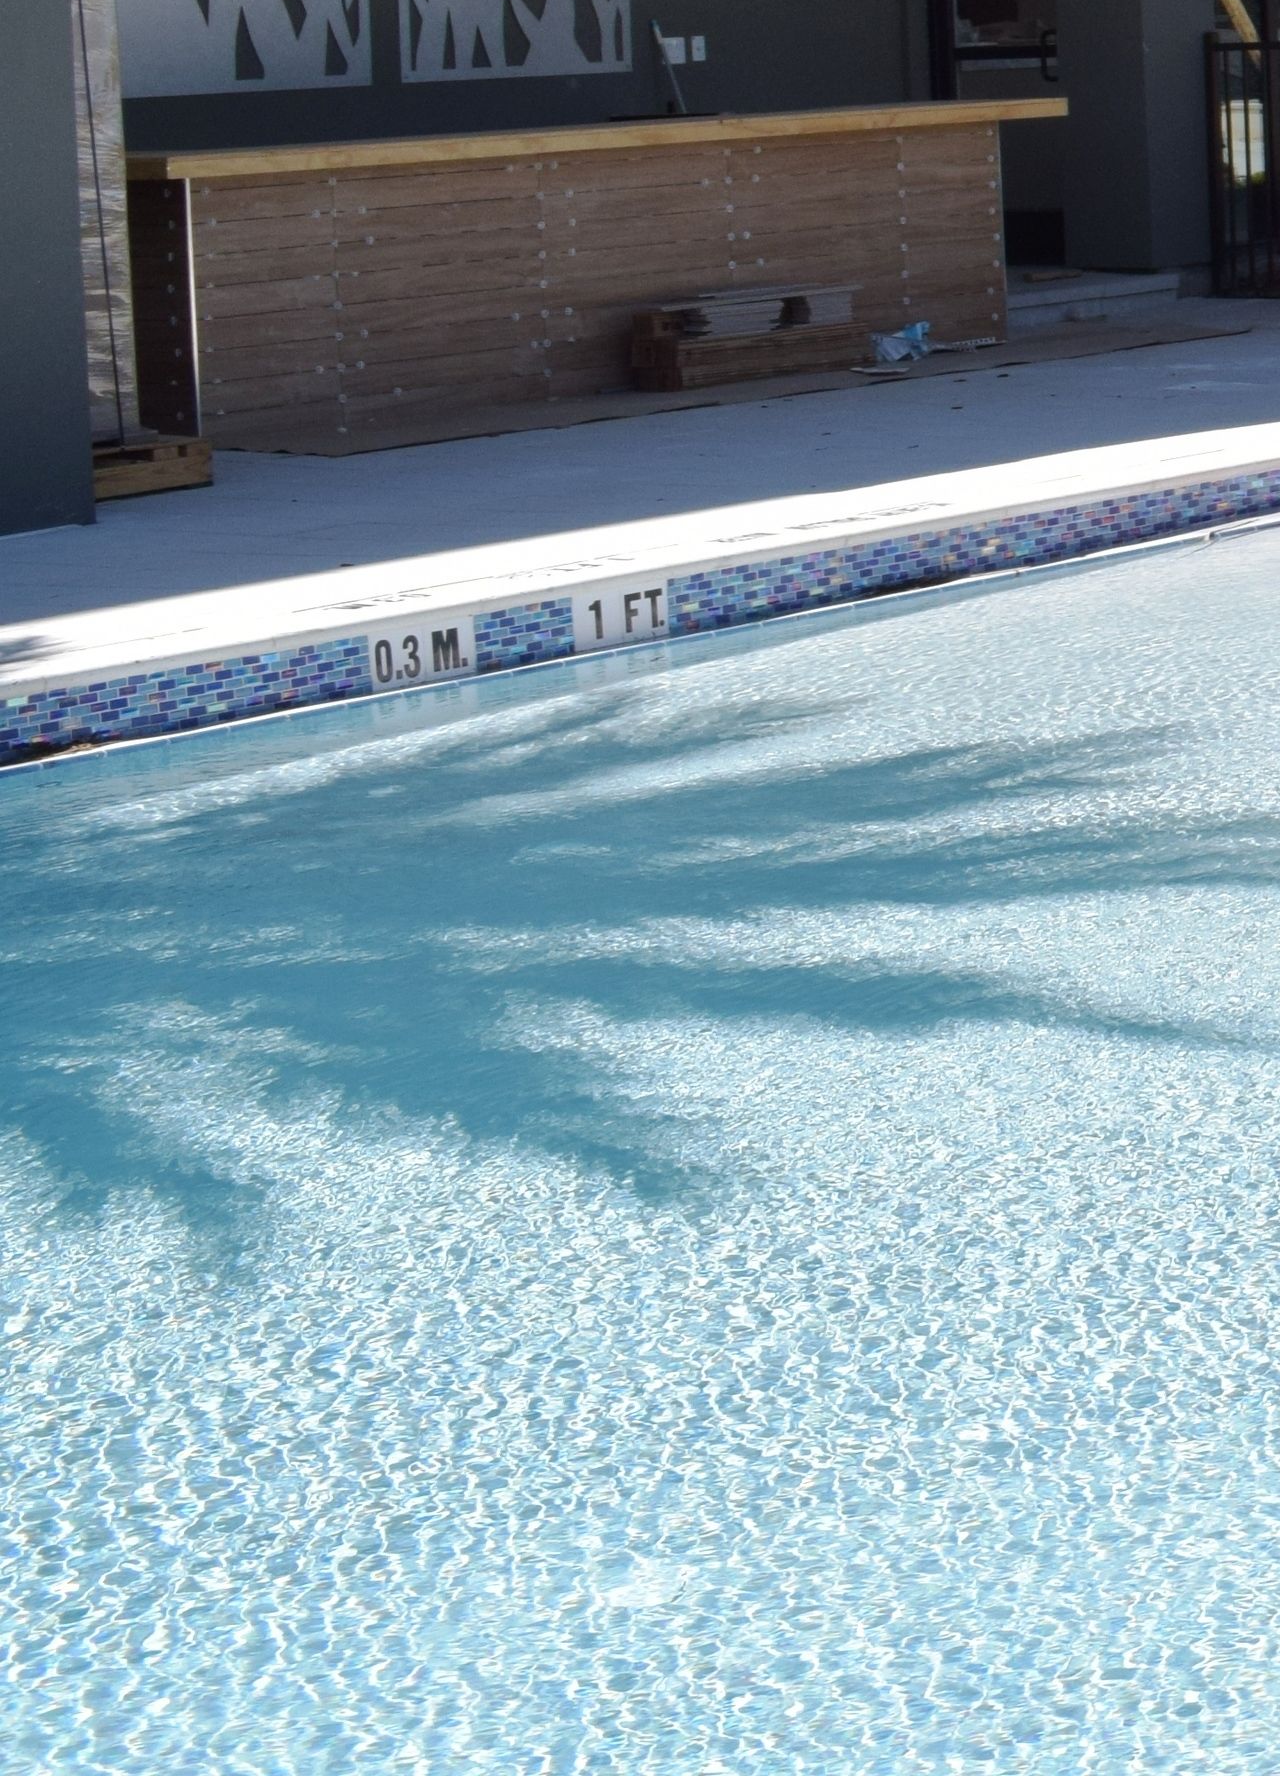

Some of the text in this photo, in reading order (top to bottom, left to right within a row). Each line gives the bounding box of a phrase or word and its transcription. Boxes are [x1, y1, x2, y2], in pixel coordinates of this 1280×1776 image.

[588, 588, 665, 640] 1 FT.
[374, 627, 469, 684] 0.3 M.
